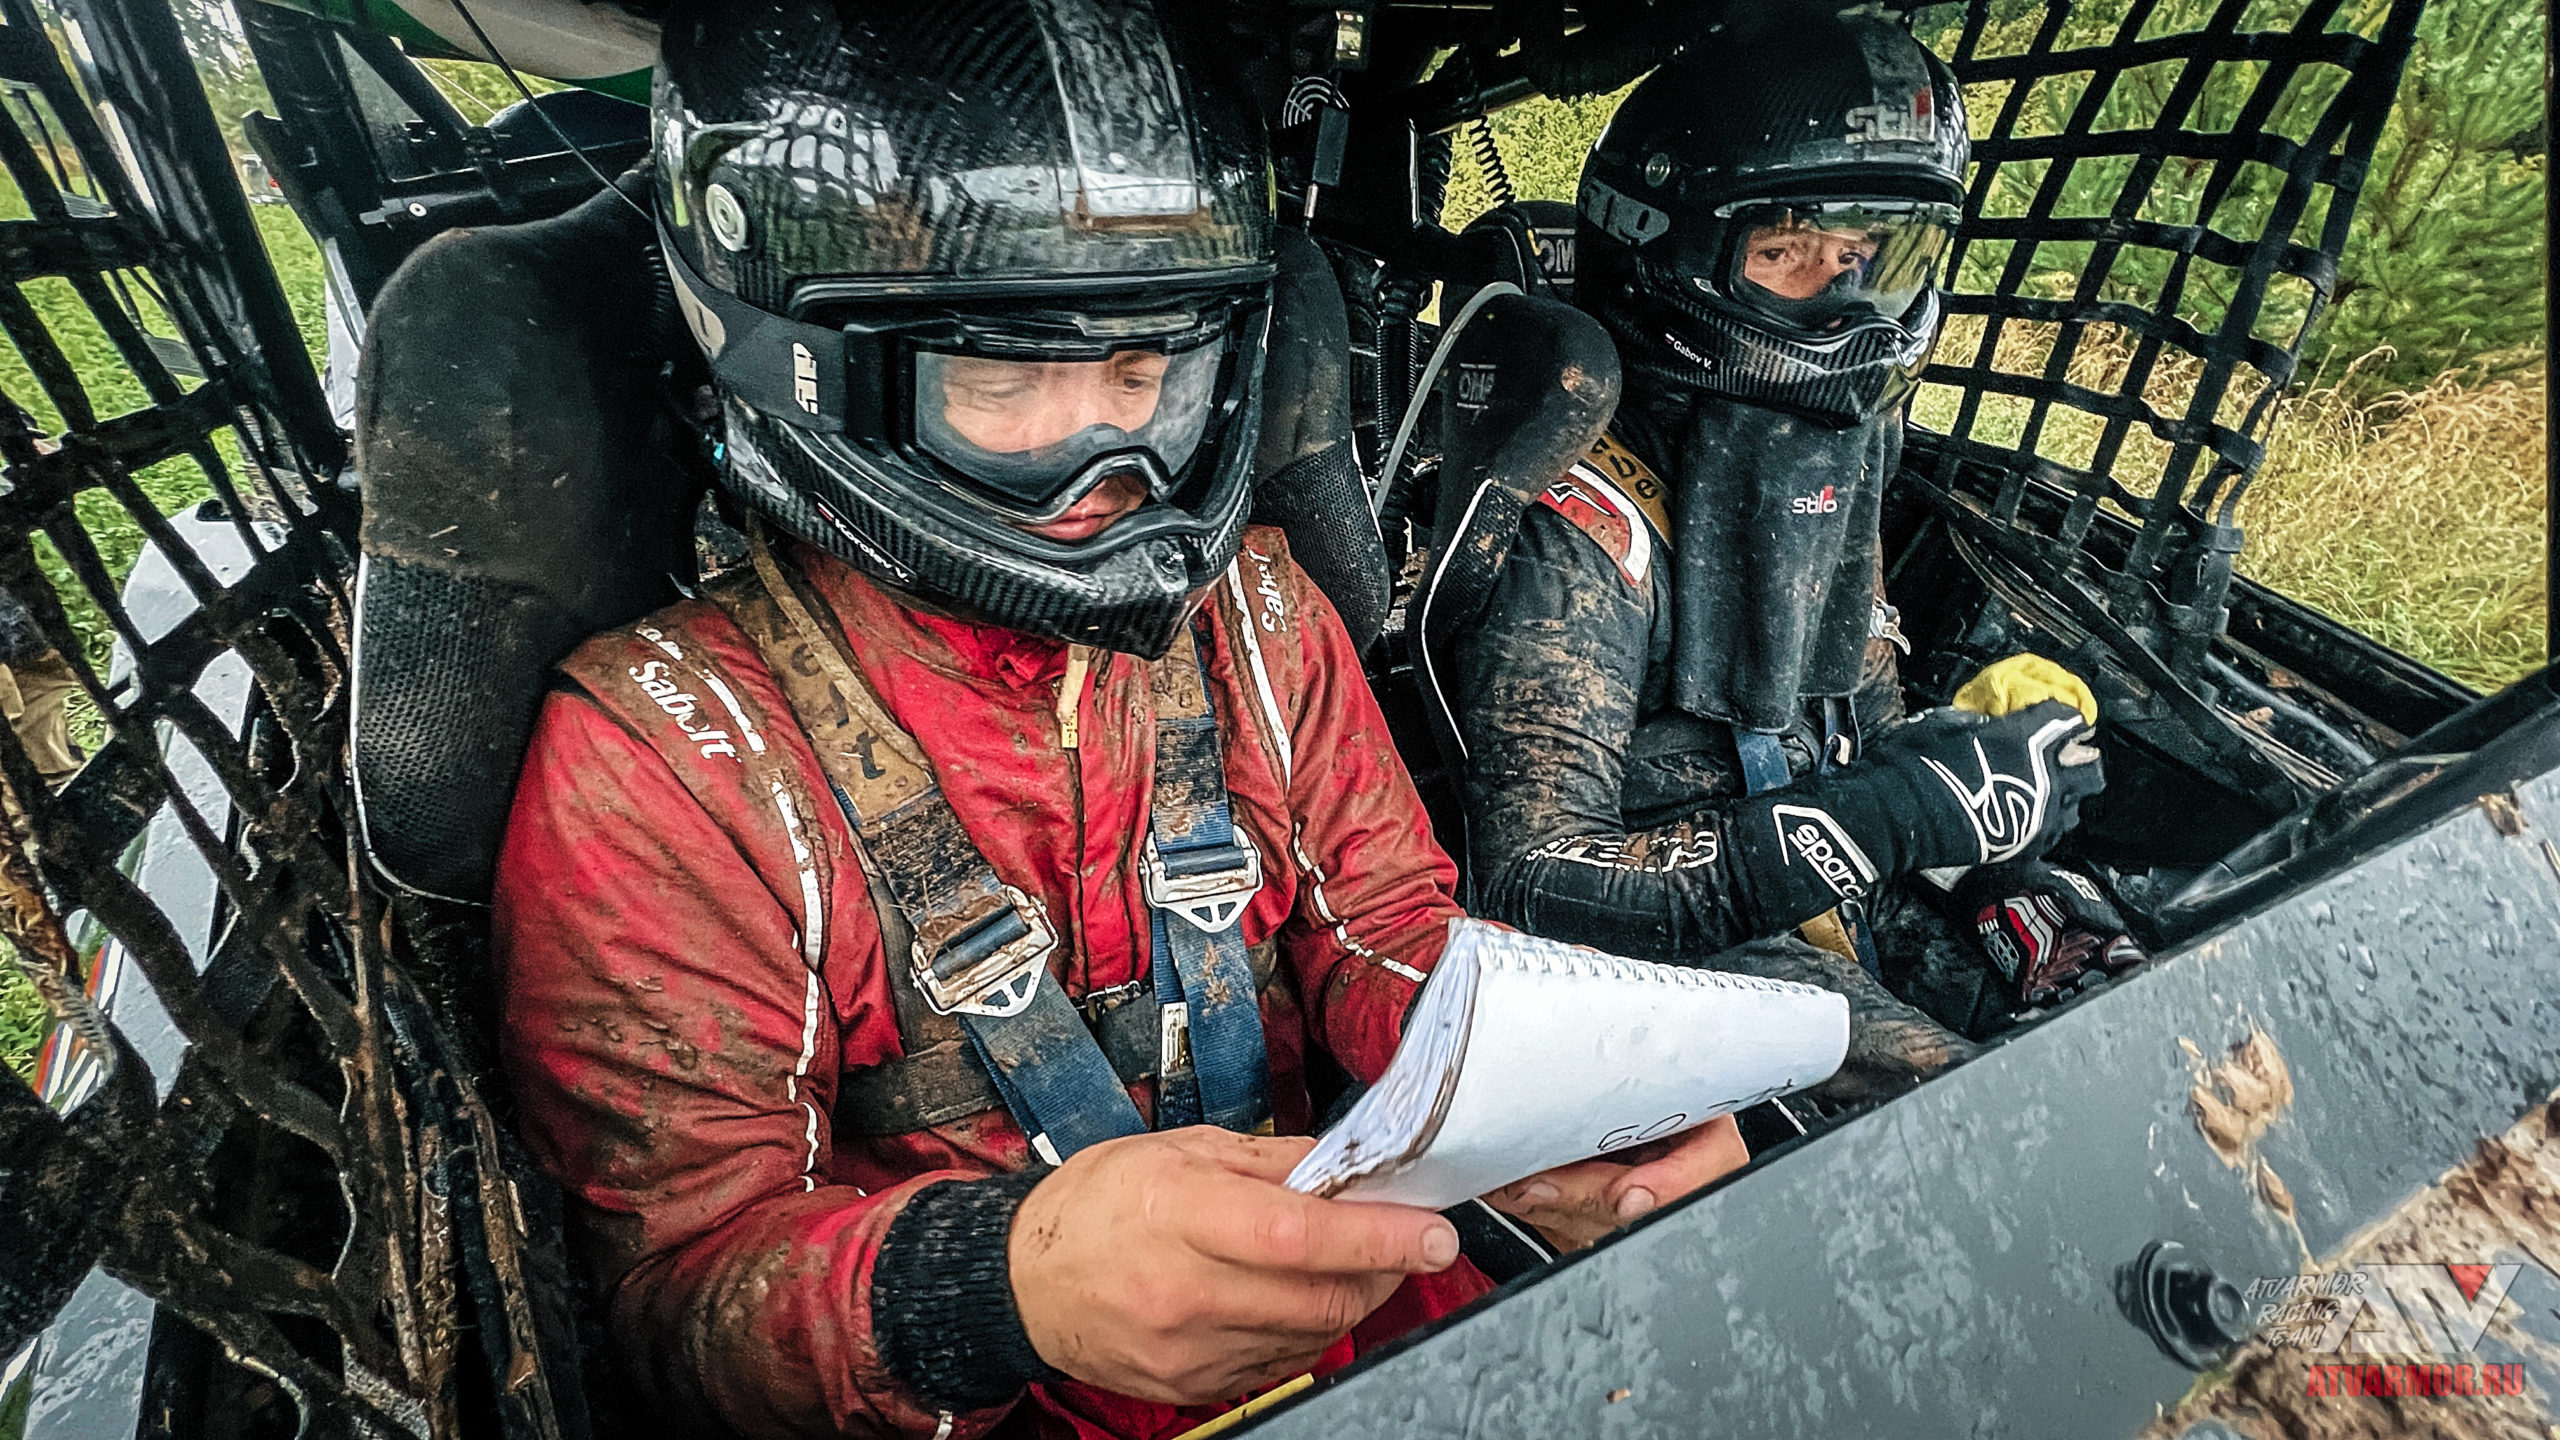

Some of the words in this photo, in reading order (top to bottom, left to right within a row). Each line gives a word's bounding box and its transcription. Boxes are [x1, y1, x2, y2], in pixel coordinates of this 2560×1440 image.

[1673, 340, 1702, 364] Gabov
[835, 518, 892, 569] Korolev
[1787, 824, 1867, 899] sparc
